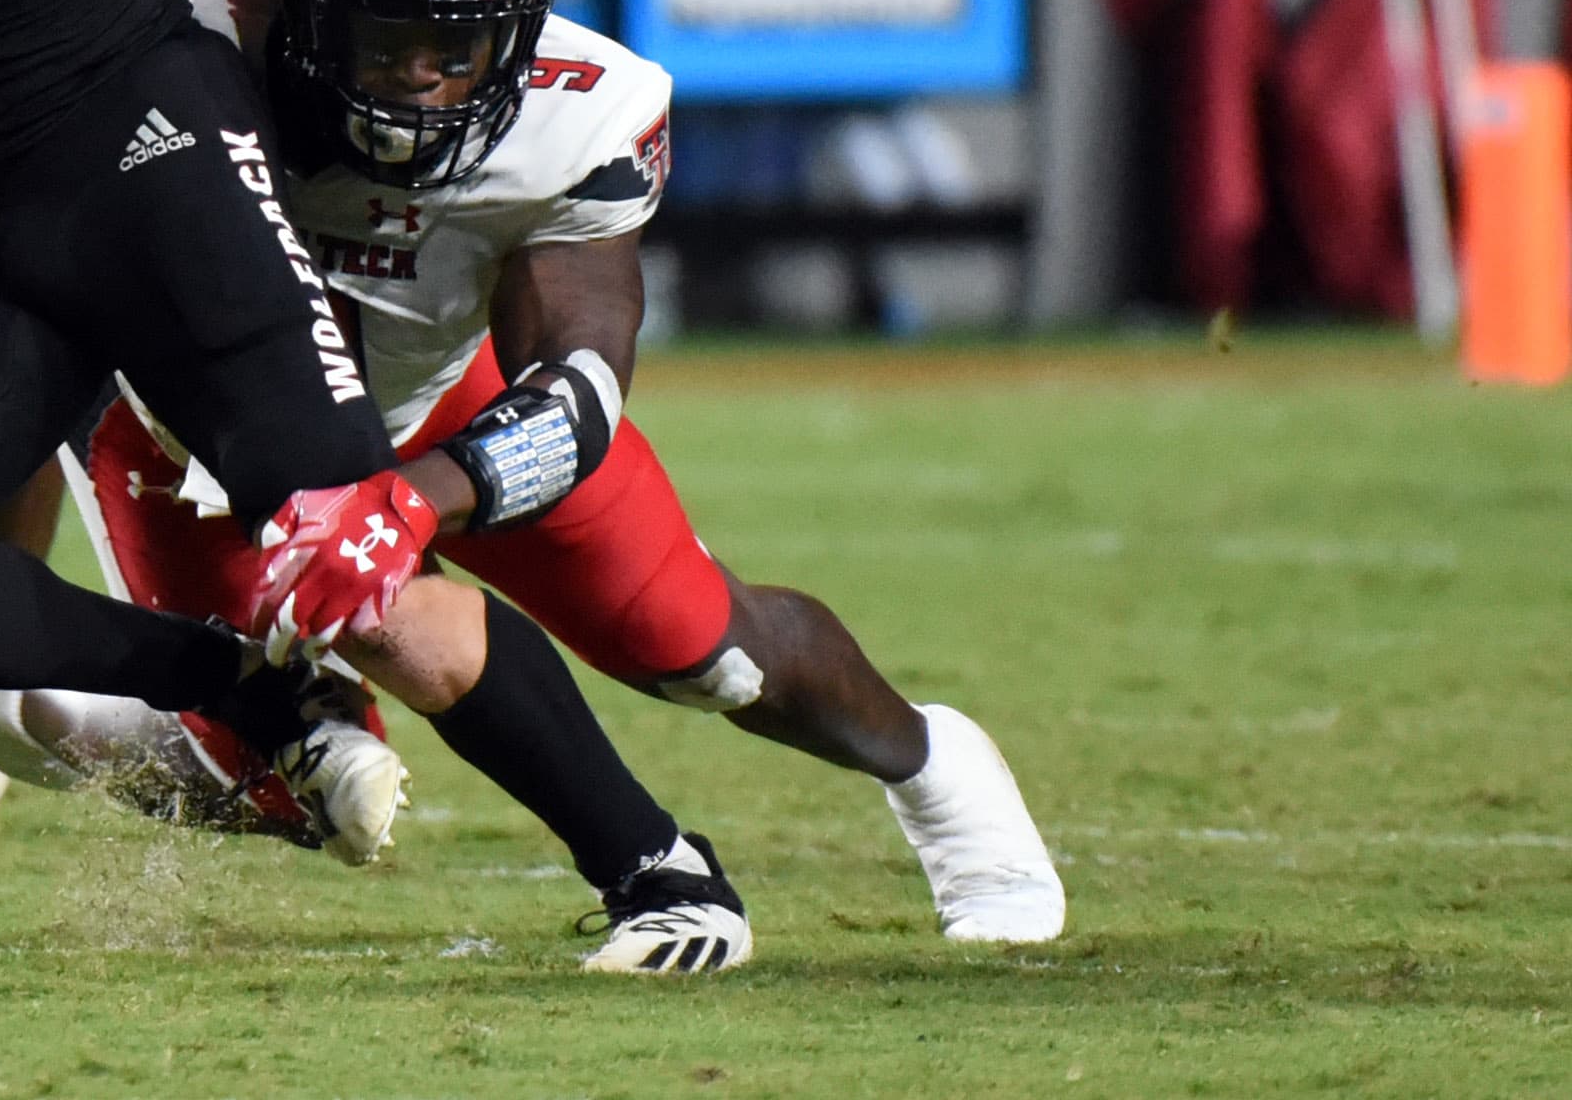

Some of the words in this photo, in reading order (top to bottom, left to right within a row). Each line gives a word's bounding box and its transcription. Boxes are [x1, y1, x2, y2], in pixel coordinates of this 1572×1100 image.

[529, 57, 607, 93] 9
[119, 132, 197, 172] adidas
[219, 129, 367, 405] WOLFPACK
[316, 233, 418, 281] TECH
